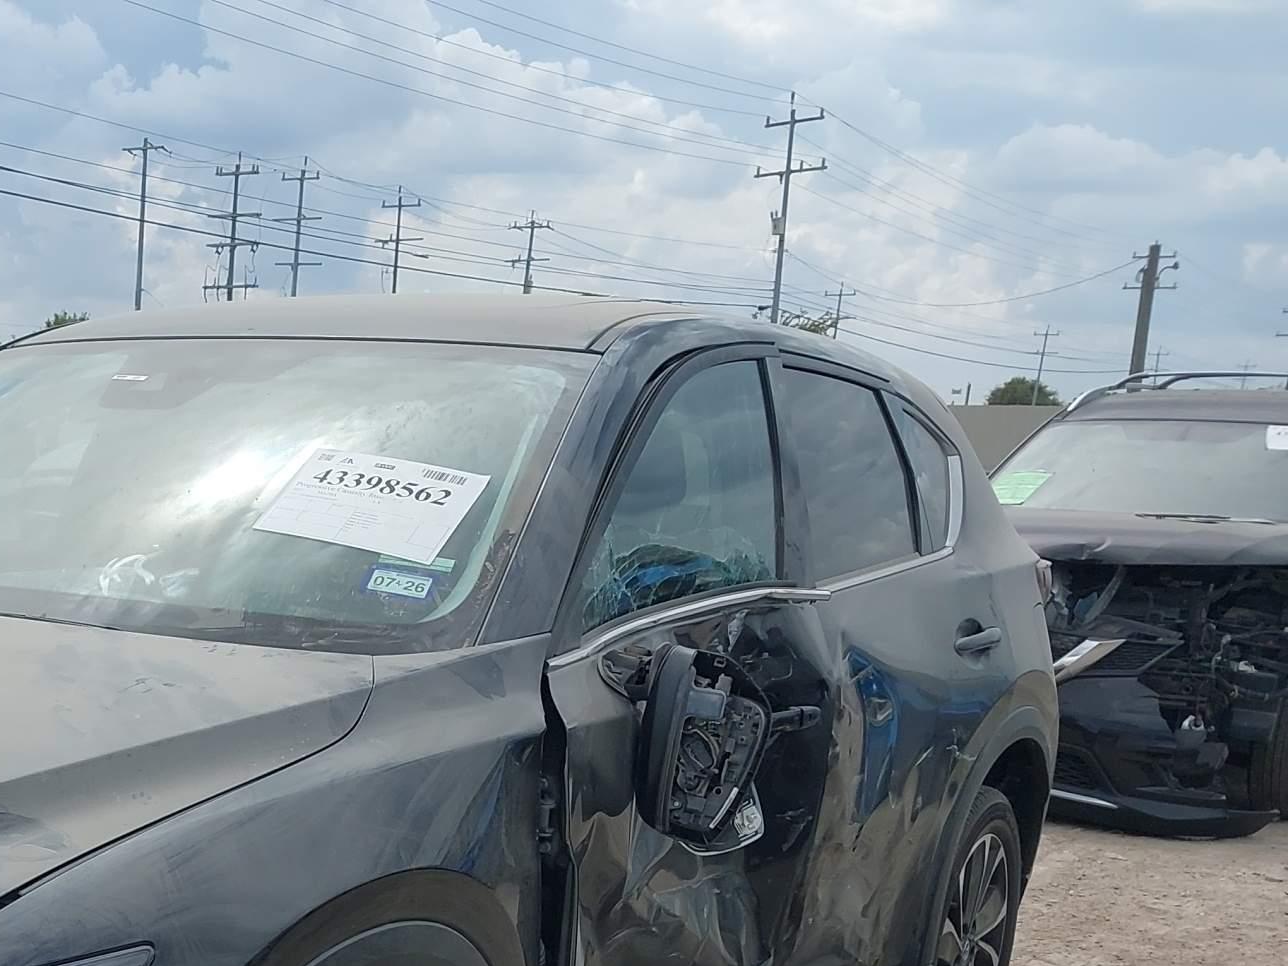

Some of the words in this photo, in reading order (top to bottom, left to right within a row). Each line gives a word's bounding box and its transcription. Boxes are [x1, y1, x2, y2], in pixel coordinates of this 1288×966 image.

[313, 468, 452, 506] 43398562
[373, 575, 396, 588] 07
[403, 580, 426, 593] 26
